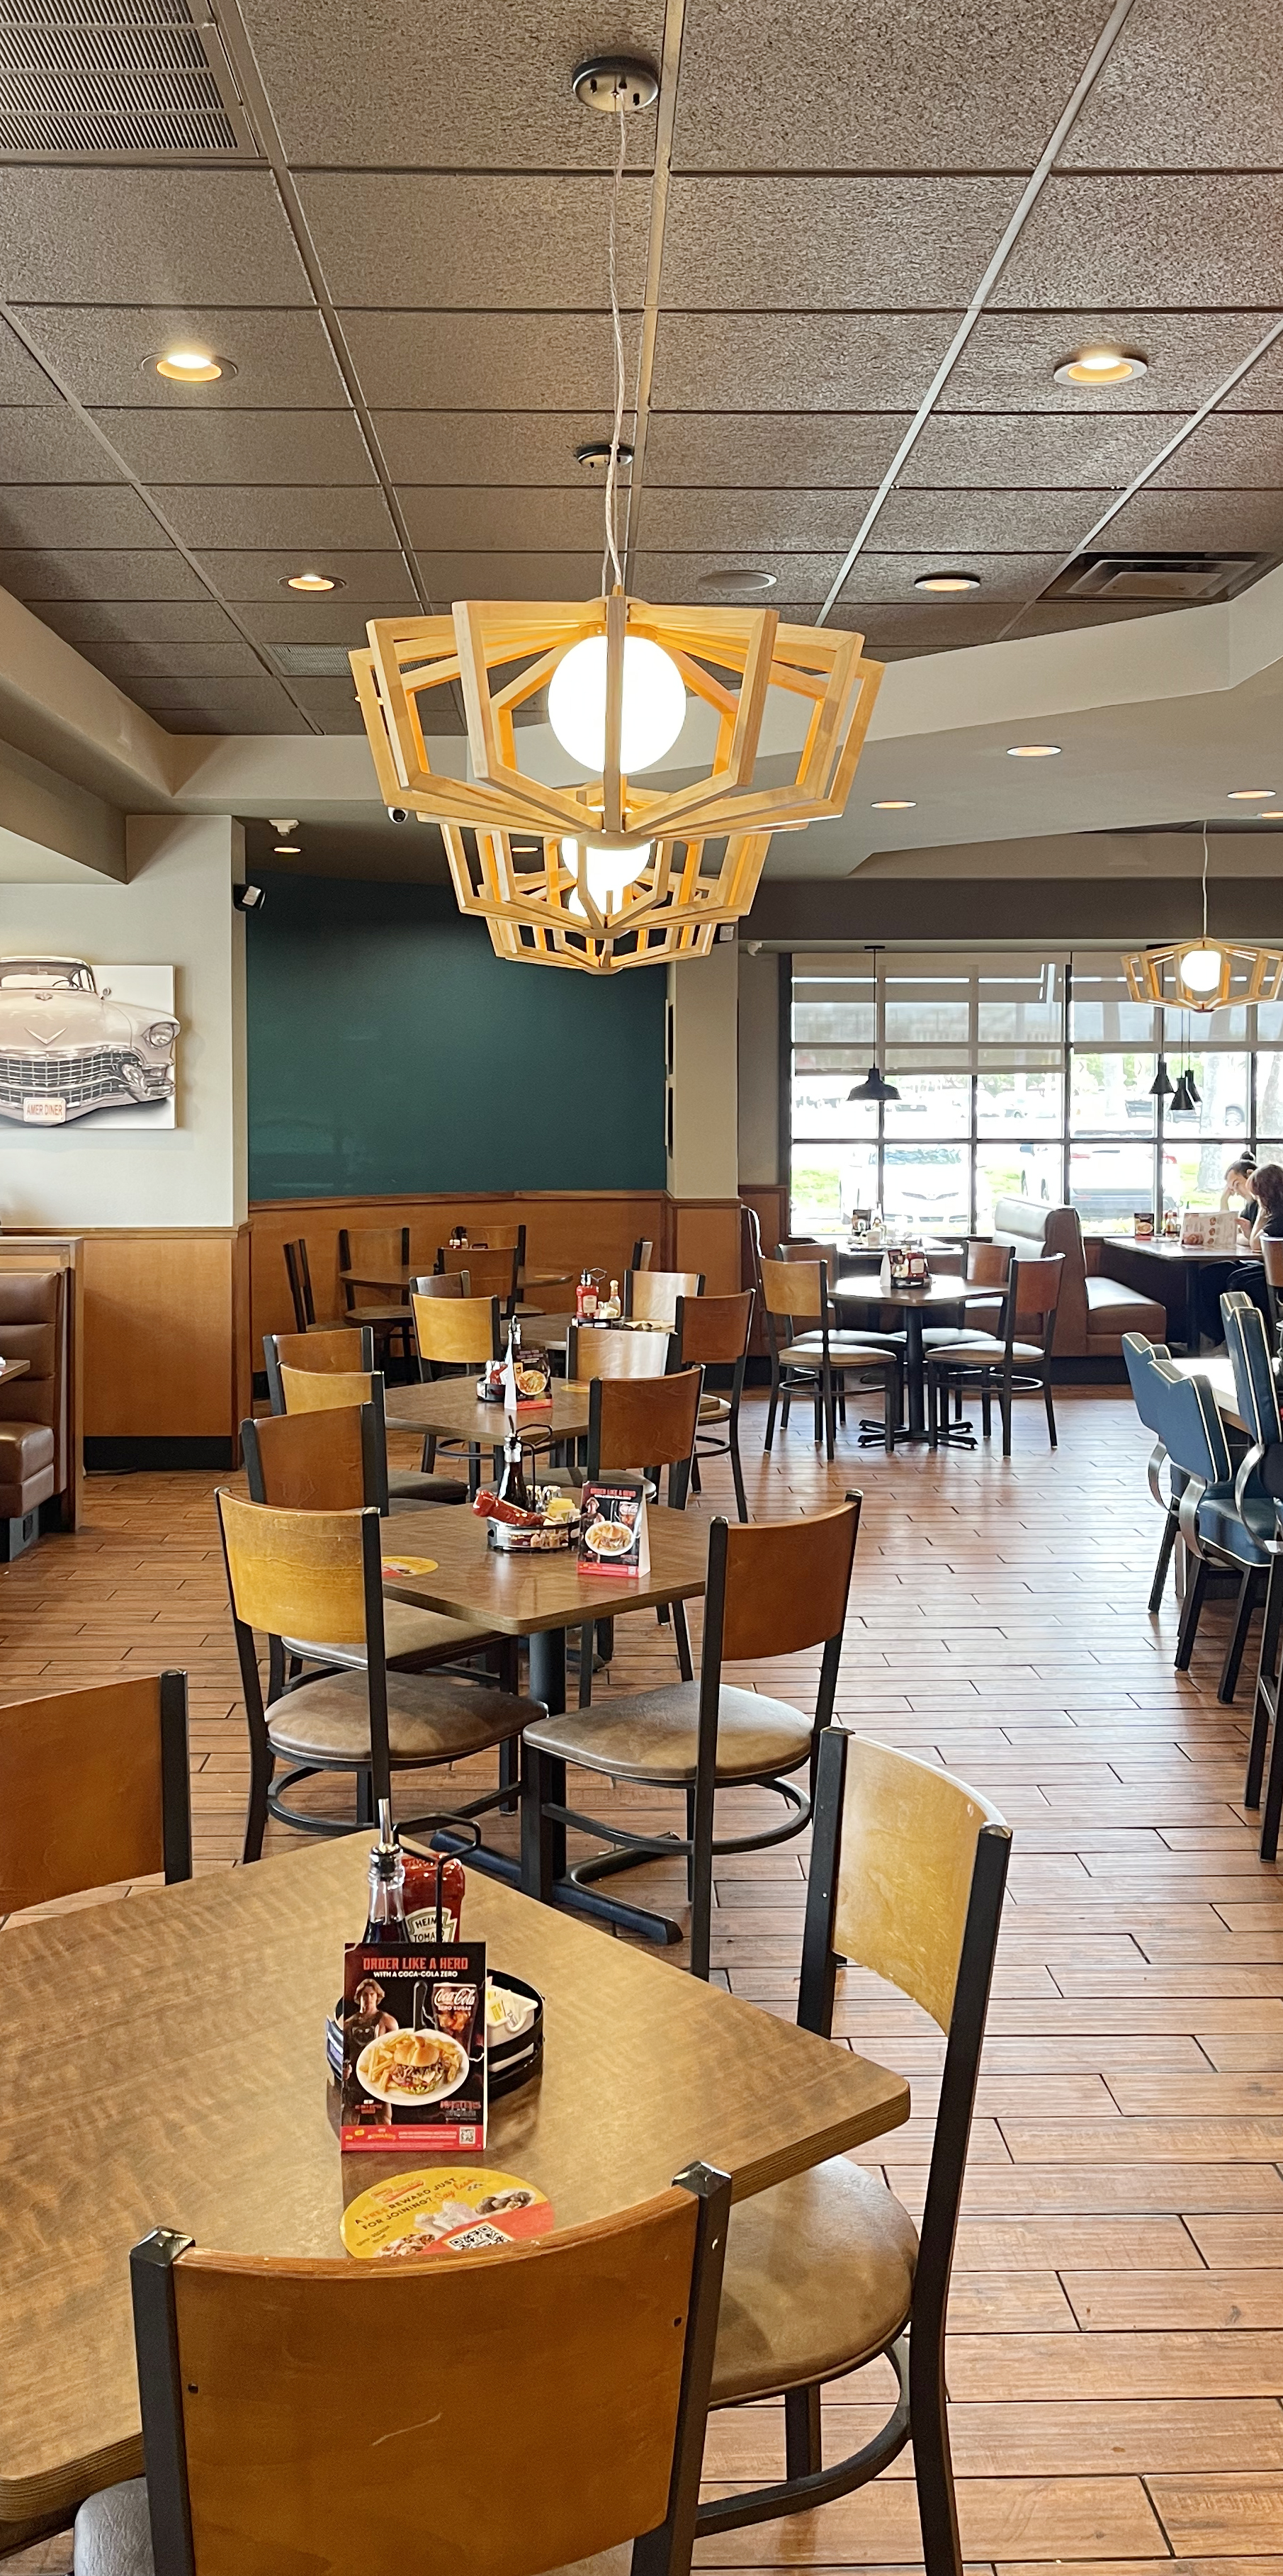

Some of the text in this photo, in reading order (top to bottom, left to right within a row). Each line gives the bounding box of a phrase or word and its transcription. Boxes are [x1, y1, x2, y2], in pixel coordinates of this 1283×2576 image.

[27, 1104, 62, 1115] AMER DINER
[415, 1916, 441, 1928] HEIN
[363, 1957, 468, 1970] ORDER LIKE A HERO
[434, 1988, 475, 2006] Coca-Cola
[388, 2189, 431, 2210] REWARD
[434, 2178, 457, 2191] JUST
[362, 2197, 433, 2229] FOR JOINING?
